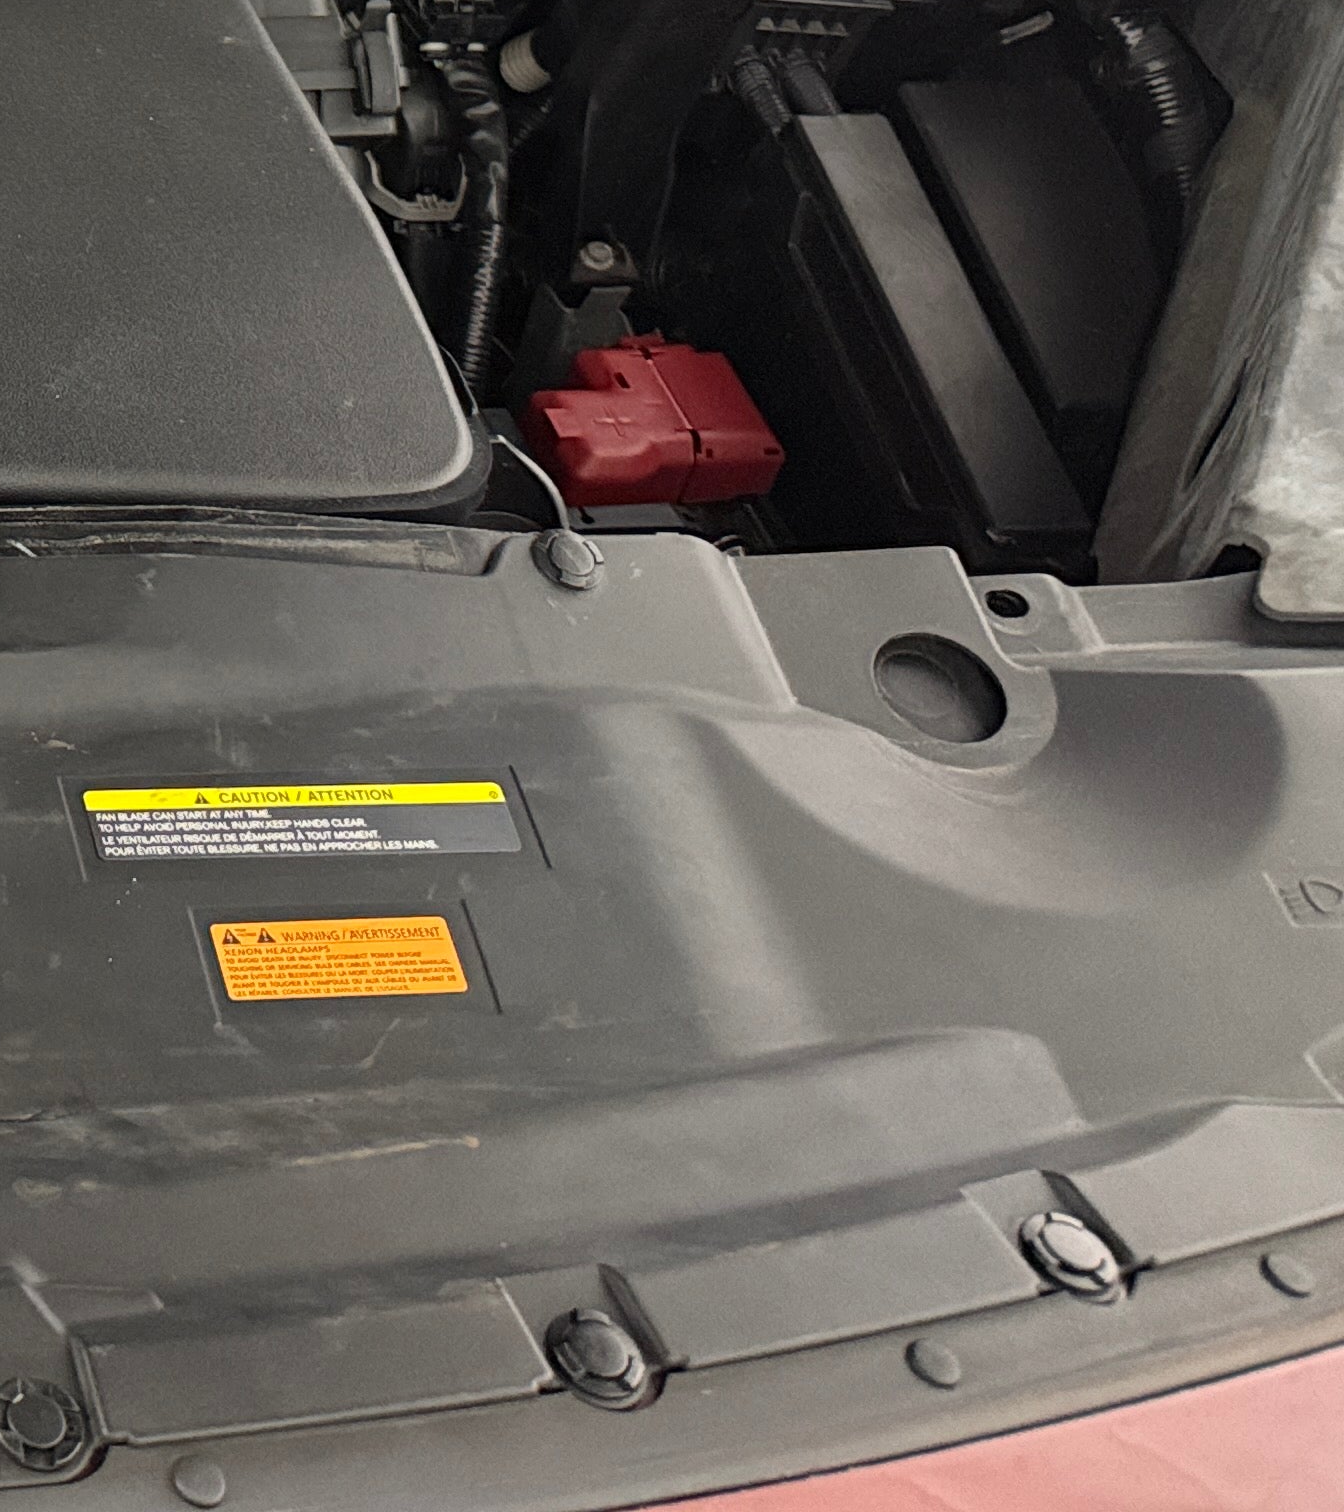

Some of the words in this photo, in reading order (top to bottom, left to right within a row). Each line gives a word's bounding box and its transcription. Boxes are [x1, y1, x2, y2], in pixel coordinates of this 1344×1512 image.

[218, 791, 290, 804] CAUTION
[308, 789, 394, 802] ATTENTION
[95, 812, 117, 822] FAN
[117, 811, 151, 821] BLADE
[152, 811, 175, 821] CAN
[176, 810, 207, 820] START
[209, 809, 221, 819] AT
[223, 809, 244, 819] ANY
[98, 823, 113, 833] TO
[115, 823, 141, 833] HELP
[143, 822, 174, 832] AVOID
[175, 821, 231, 831] PERSONAL
[293, 818, 330, 828] HANDS
[101, 835, 115, 845] LE
[116, 834, 182, 845] VENTILATEUR
[223, 833, 238, 842] DE
[305, 830, 332, 840] TOUT
[104, 846, 135, 856] POUR
[172, 845, 206, 854] TOUTE
[263, 843, 279, 852] NE
[279, 842, 301, 852] PAS
[302, 842, 317, 851] EN
[318, 841, 382, 851] APPROCHER
[384, 840, 403, 849] LES
[281, 930, 340, 942] WARNING
[349, 927, 440, 940] AVERTISSEMENT
[223, 947, 262, 956] XENON
[265, 945, 331, 954] HEADLAMPS
